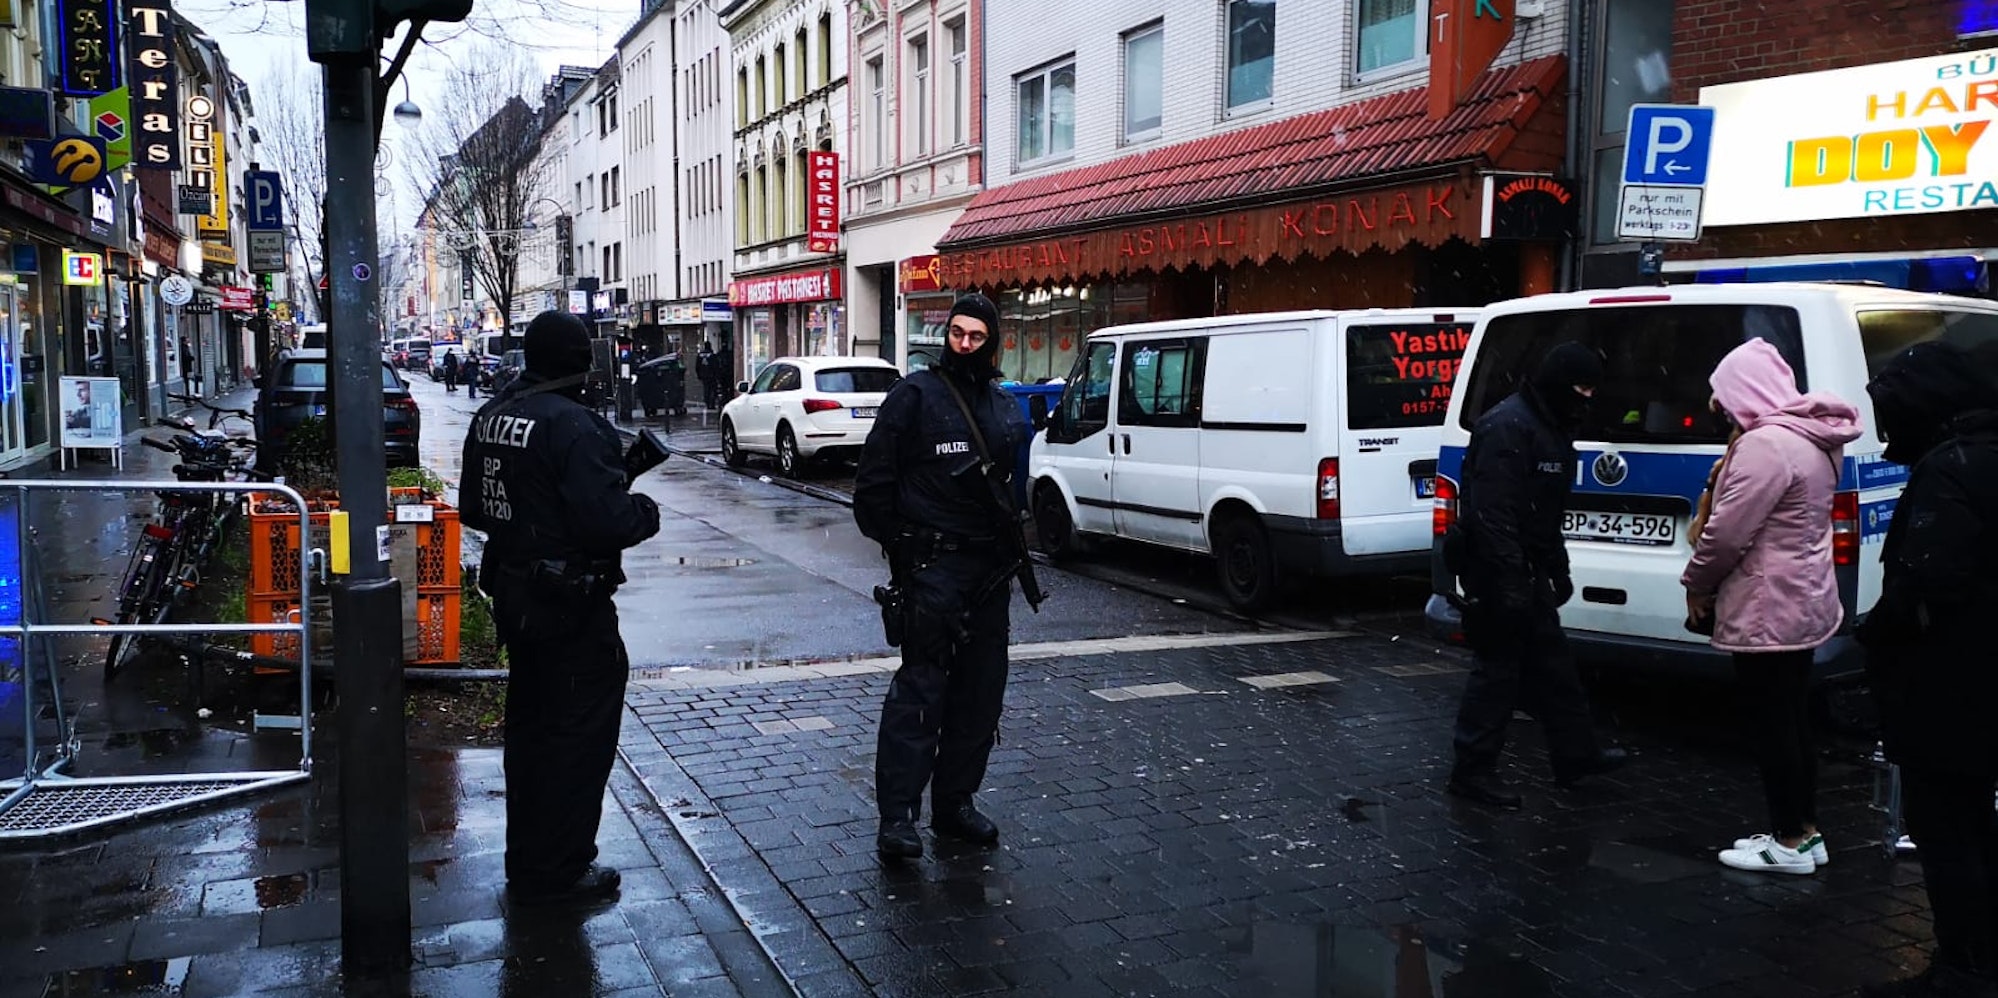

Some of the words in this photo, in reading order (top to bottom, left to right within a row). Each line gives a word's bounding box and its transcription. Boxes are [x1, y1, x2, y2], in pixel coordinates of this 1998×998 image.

[73, 0, 102, 90] ANT
[132, 7, 172, 163] Teras
[1644, 116, 1693, 174] P
[1785, 119, 1991, 188] DOY
[255, 179, 273, 223] P
[816, 155, 834, 229] HASRET
[1281, 185, 1455, 240] KONAK
[1629, 205, 1693, 217] Parkschein
[1640, 194, 1659, 203] nur
[69, 257, 92, 278] EC
[482, 476, 507, 500] STA
[483, 456, 500, 476] BP
[1599, 515, 1671, 538] 34-596
